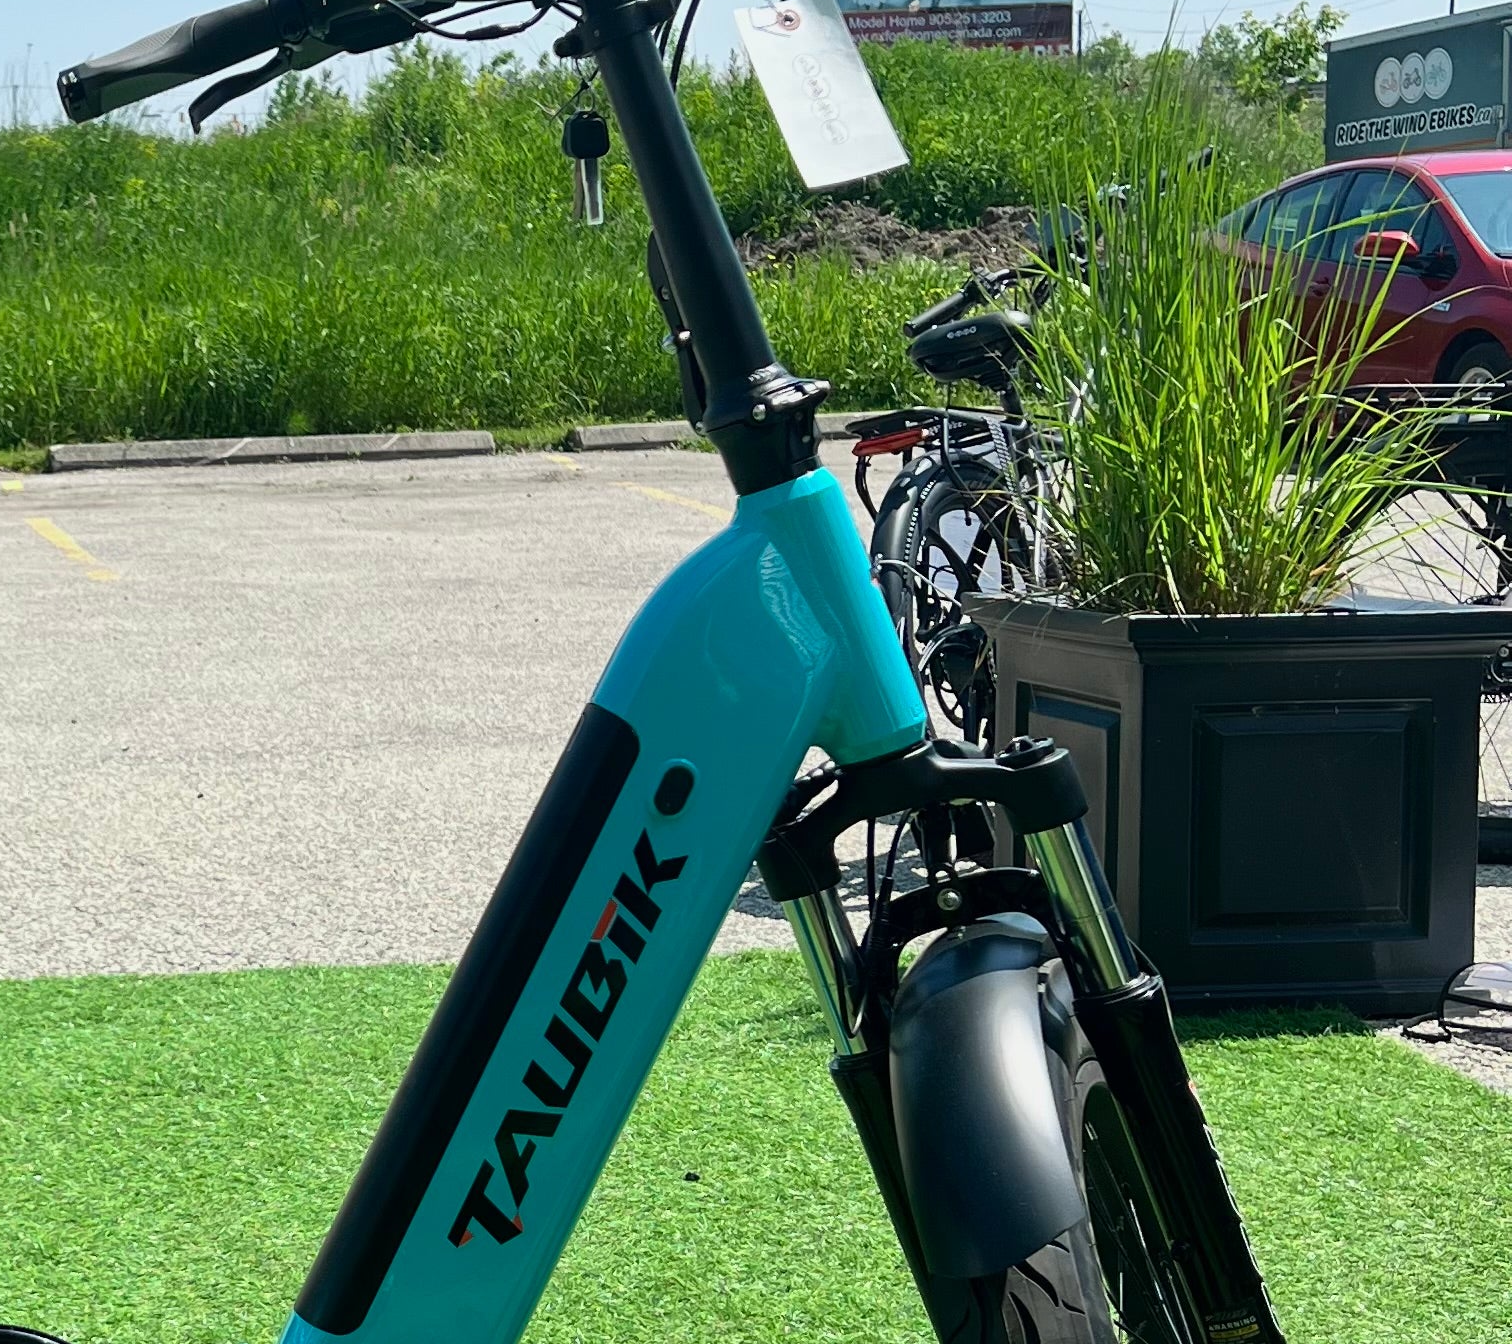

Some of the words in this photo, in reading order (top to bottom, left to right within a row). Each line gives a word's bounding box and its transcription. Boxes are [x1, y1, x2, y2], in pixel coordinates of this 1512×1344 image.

[848, 15, 887, 30] Model
[890, 13, 926, 27] Home
[1336, 122, 1367, 145] RIDE
[1368, 118, 1391, 141] THE
[1392, 112, 1427, 137] WIND
[447, 827, 688, 1248] TAUBIK
[1214, 1315, 1257, 1331] WARNING
